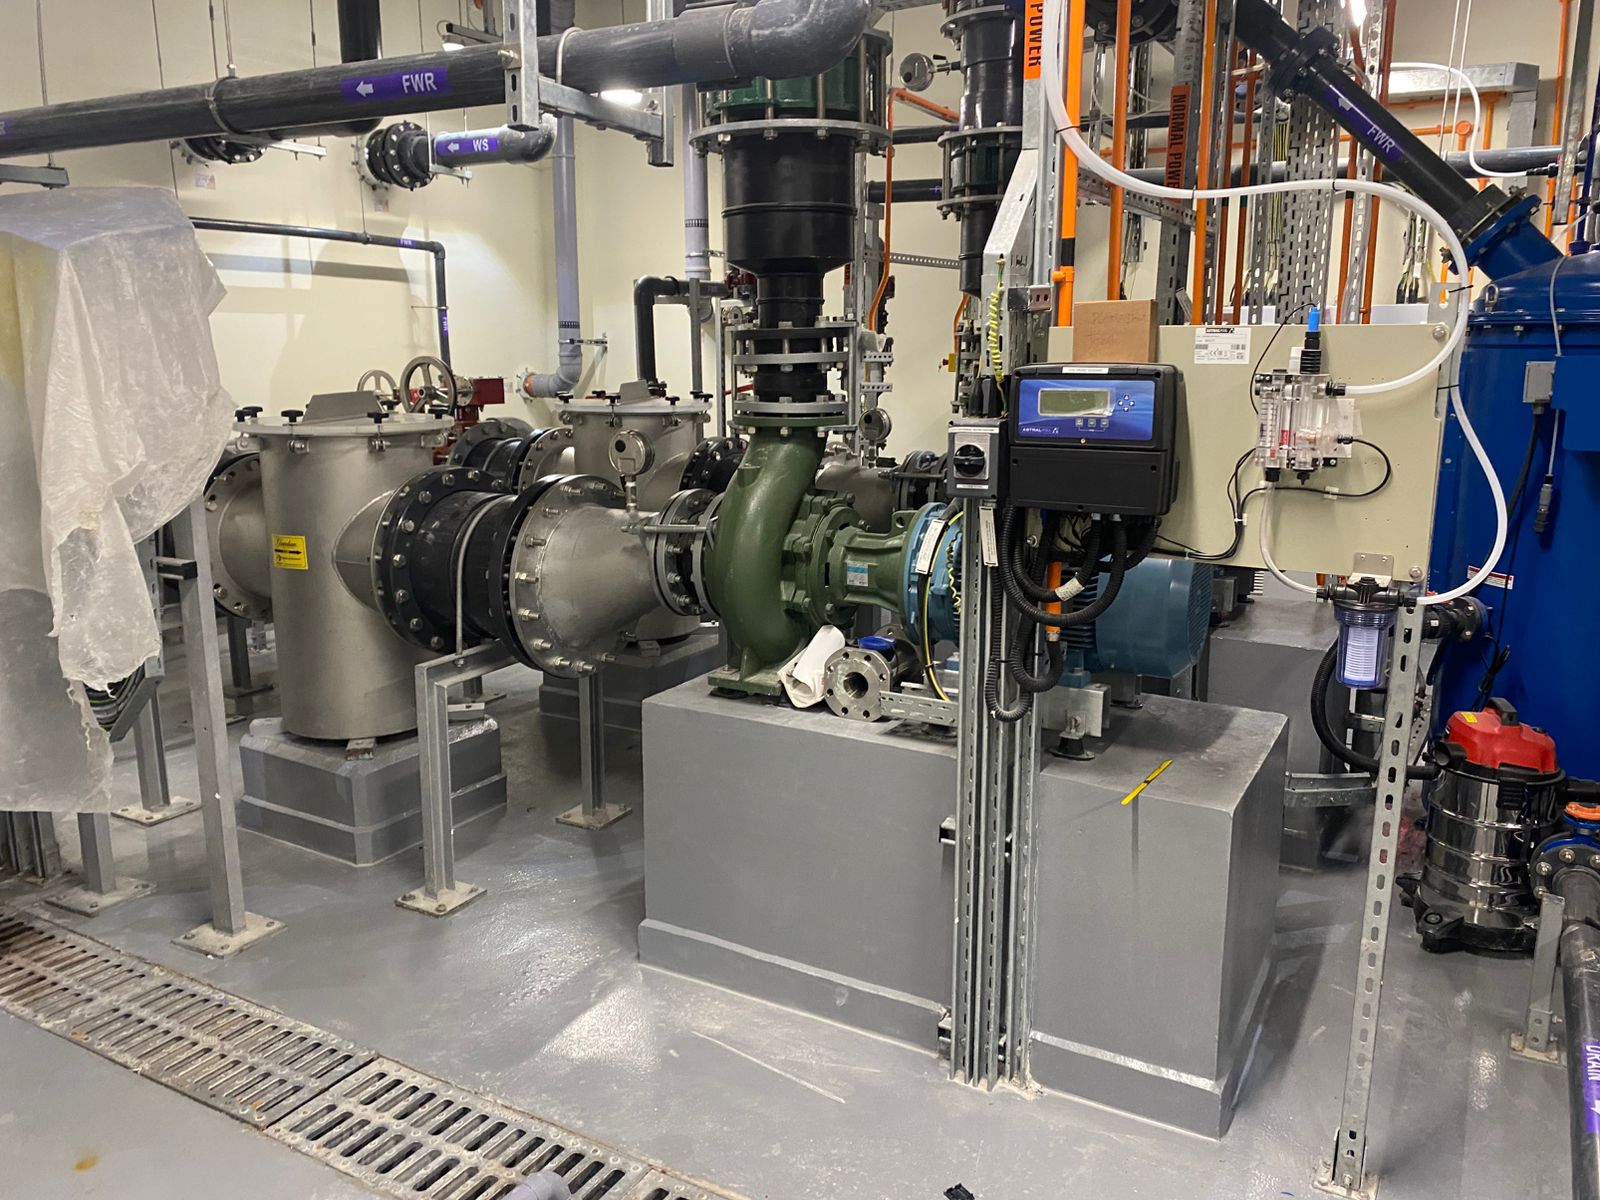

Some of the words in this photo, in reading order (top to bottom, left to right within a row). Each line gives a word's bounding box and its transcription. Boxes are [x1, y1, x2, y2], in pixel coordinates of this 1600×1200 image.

[402, 72, 437, 93] FWR
[1169, 94, 1186, 149] NORMAL
[472, 138, 489, 152] WS
[1367, 125, 1396, 153] FWR
[1166, 152, 1182, 189] POWE
